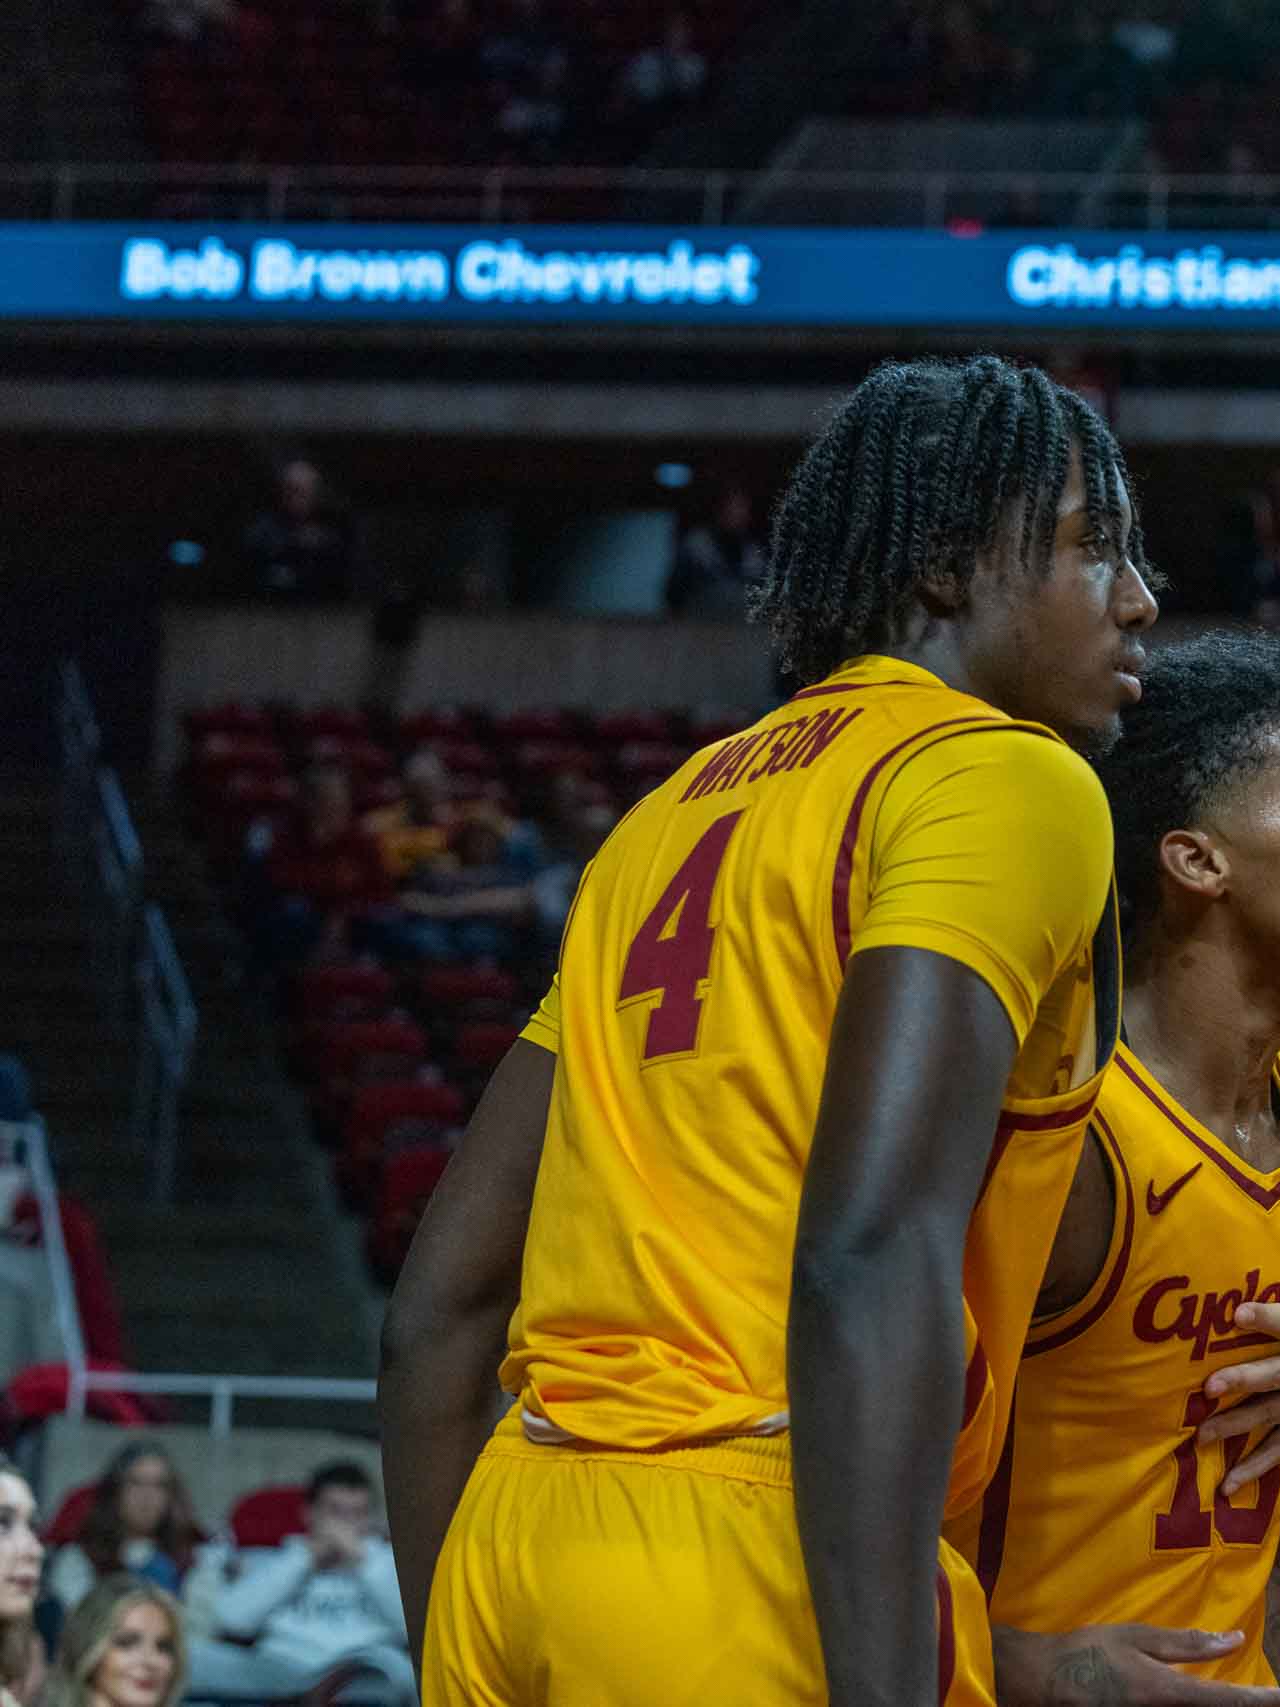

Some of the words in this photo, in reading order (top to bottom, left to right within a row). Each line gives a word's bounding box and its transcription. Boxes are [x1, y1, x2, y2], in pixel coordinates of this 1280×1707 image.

[122, 239, 241, 302] Bob
[251, 240, 446, 301] Brown
[458, 241, 757, 305] Chevrolet
[678, 706, 864, 804] WATSON
[616, 805, 748, 1063] 4
